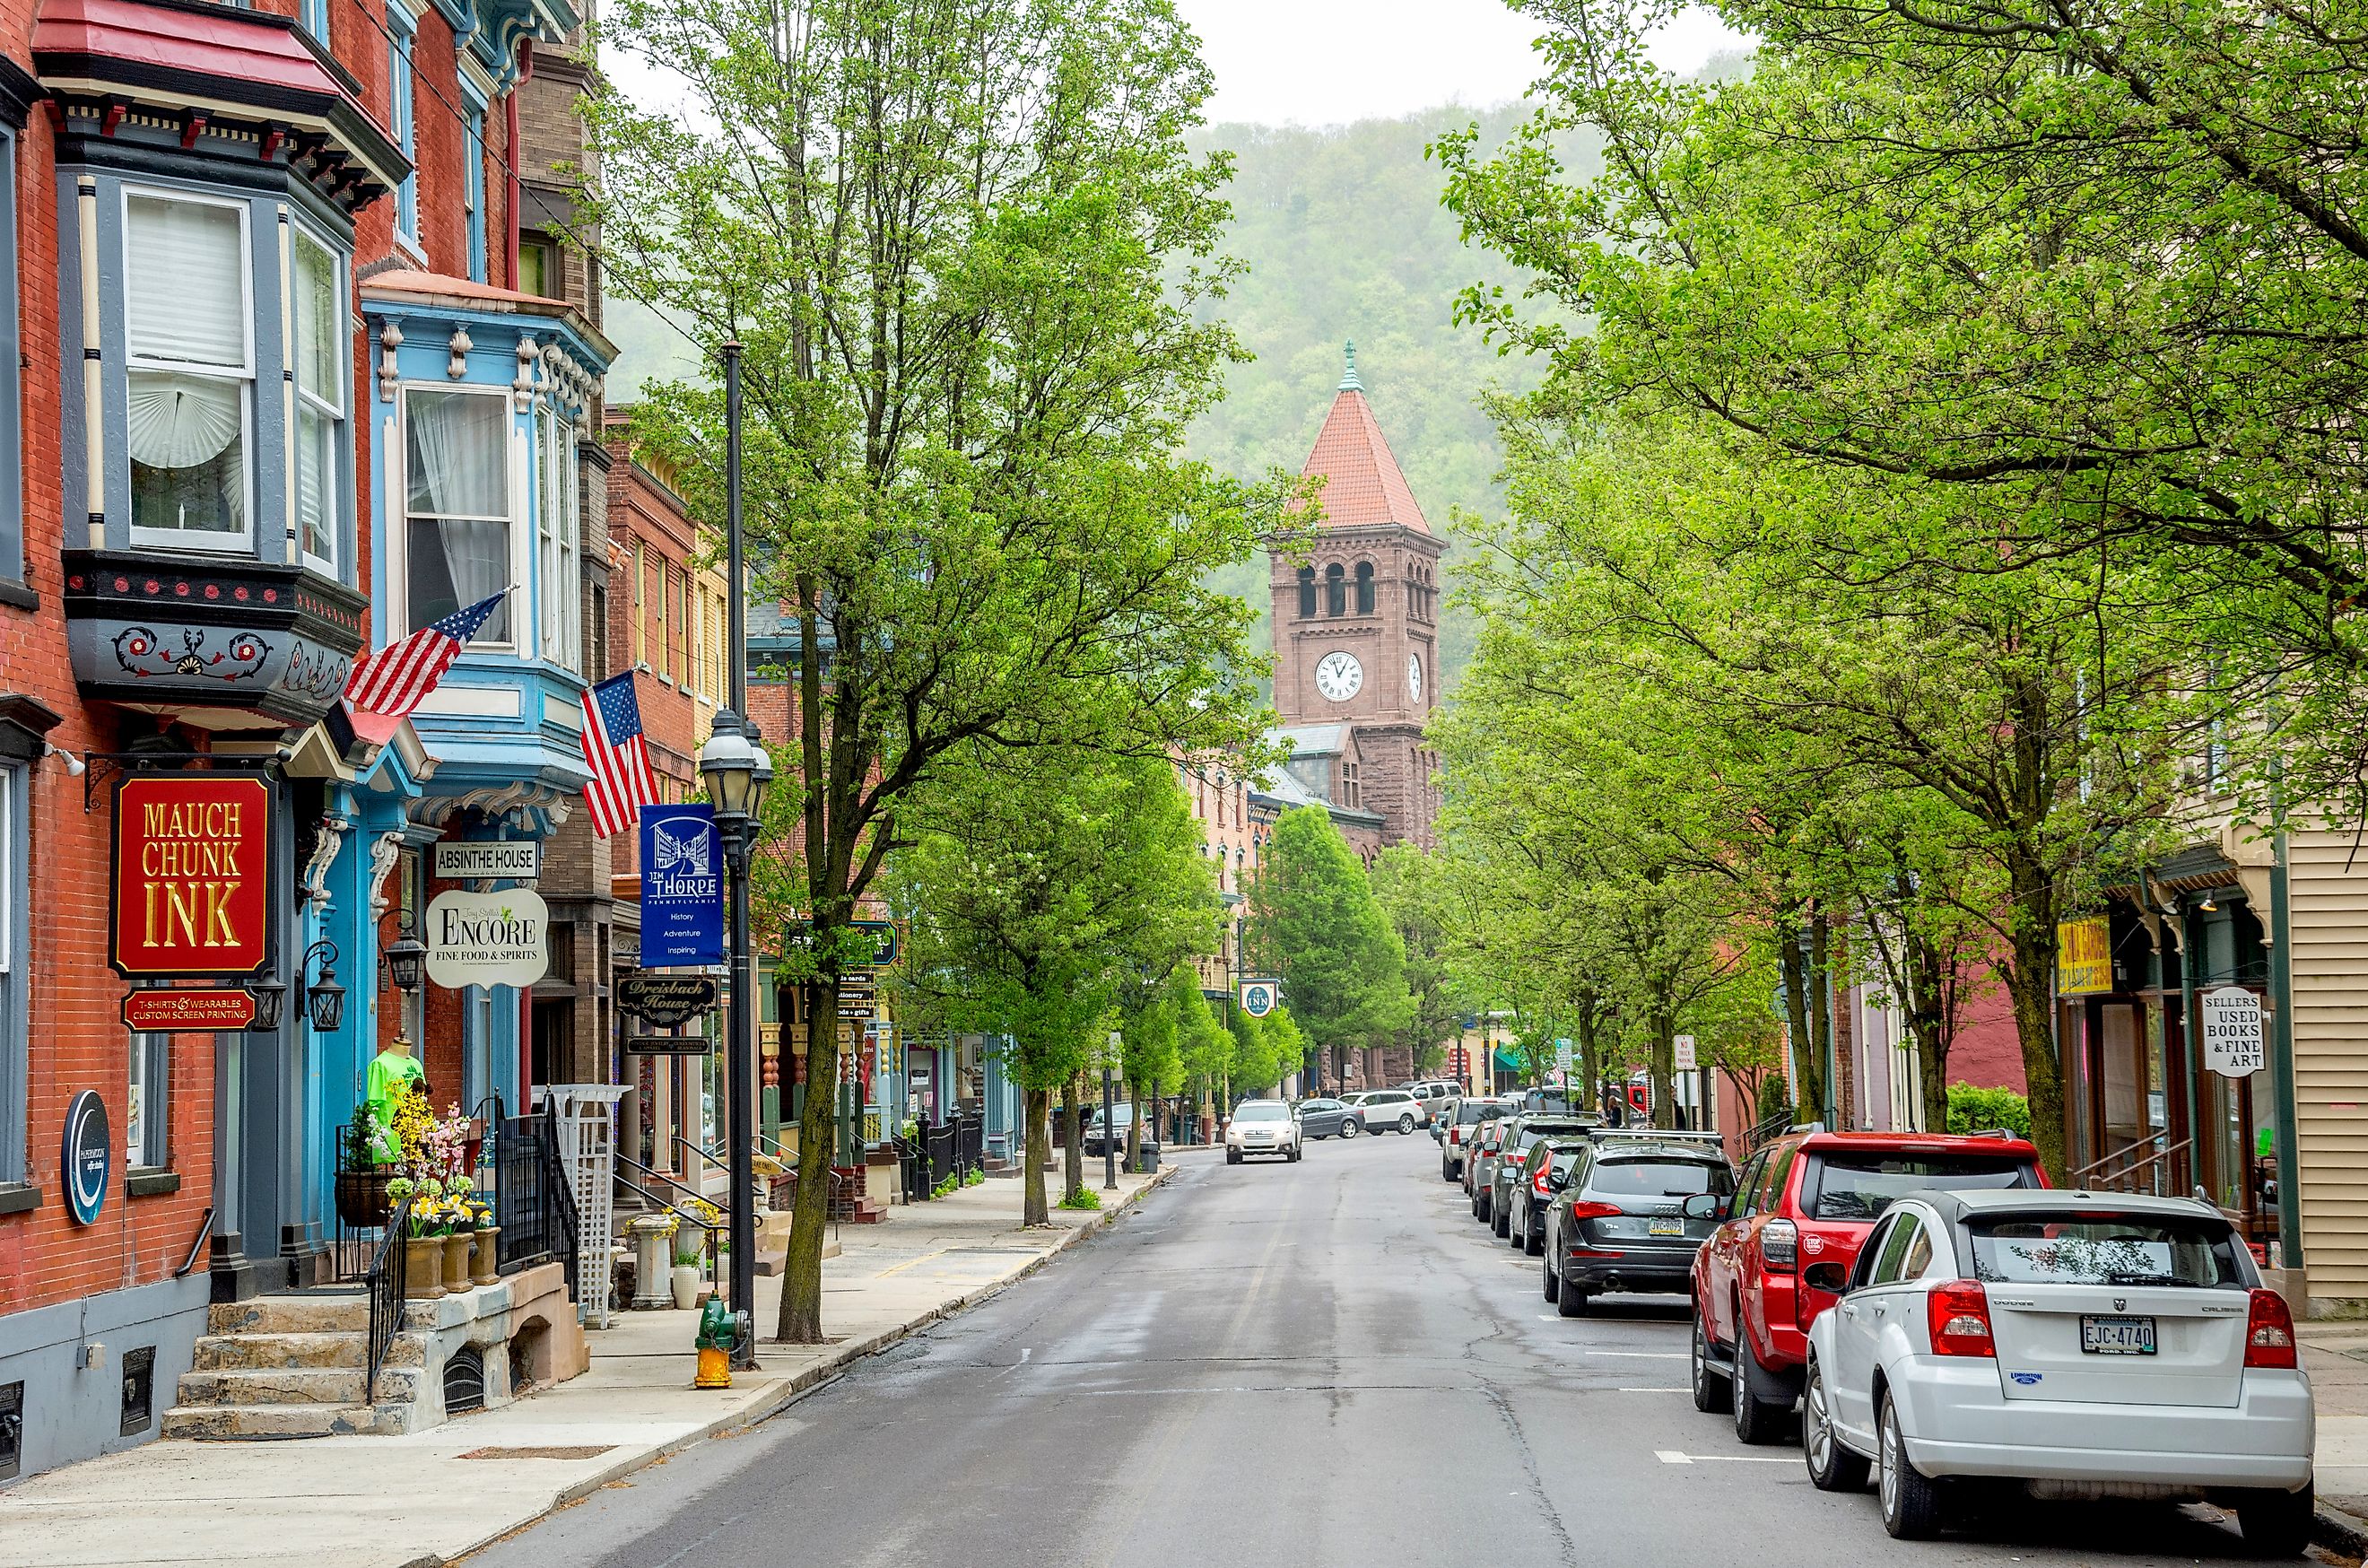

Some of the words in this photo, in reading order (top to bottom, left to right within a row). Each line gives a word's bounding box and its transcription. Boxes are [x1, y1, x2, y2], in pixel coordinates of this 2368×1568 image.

[143, 802, 242, 838] MAUCH
[142, 841, 242, 877] CHUNK
[438, 849, 493, 869] ABSINTHE
[495, 849, 534, 868] HOUSE
[648, 871, 665, 882] JIM
[652, 873, 717, 899] THORPE
[143, 881, 242, 947] INK
[670, 913, 694, 921] History
[439, 908, 536, 947] ENCORE
[436, 951, 459, 961] FINE
[461, 951, 489, 961] FOOD
[491, 951, 499, 961] &
[500, 950, 537, 961] SPIRITS
[667, 946, 697, 955] Inspiring
[628, 980, 705, 995] Dreisbach
[139, 1000, 177, 1009] T-SHIRTS
[177, 997, 190, 1010] &
[190, 999, 241, 1008] WEARABLES
[641, 994, 692, 1008] House
[1248, 997, 1268, 1006] INN
[2206, 997, 2259, 1007] SELLERS
[133, 1011, 170, 1020] CUSTOM
[172, 1010, 205, 1019] SCREEN
[206, 1010, 247, 1019] PRINTING
[2218, 1011, 2259, 1024] USED
[2207, 1024, 2259, 1037] BOOKS
[1680, 1041, 1688, 1049] NO
[2214, 1043, 2223, 1052] &
[2225, 1041, 2260, 1053] FINE
[2230, 1055, 2261, 1067] ART
[2010, 1372, 2042, 1381] LEHIGHTON
